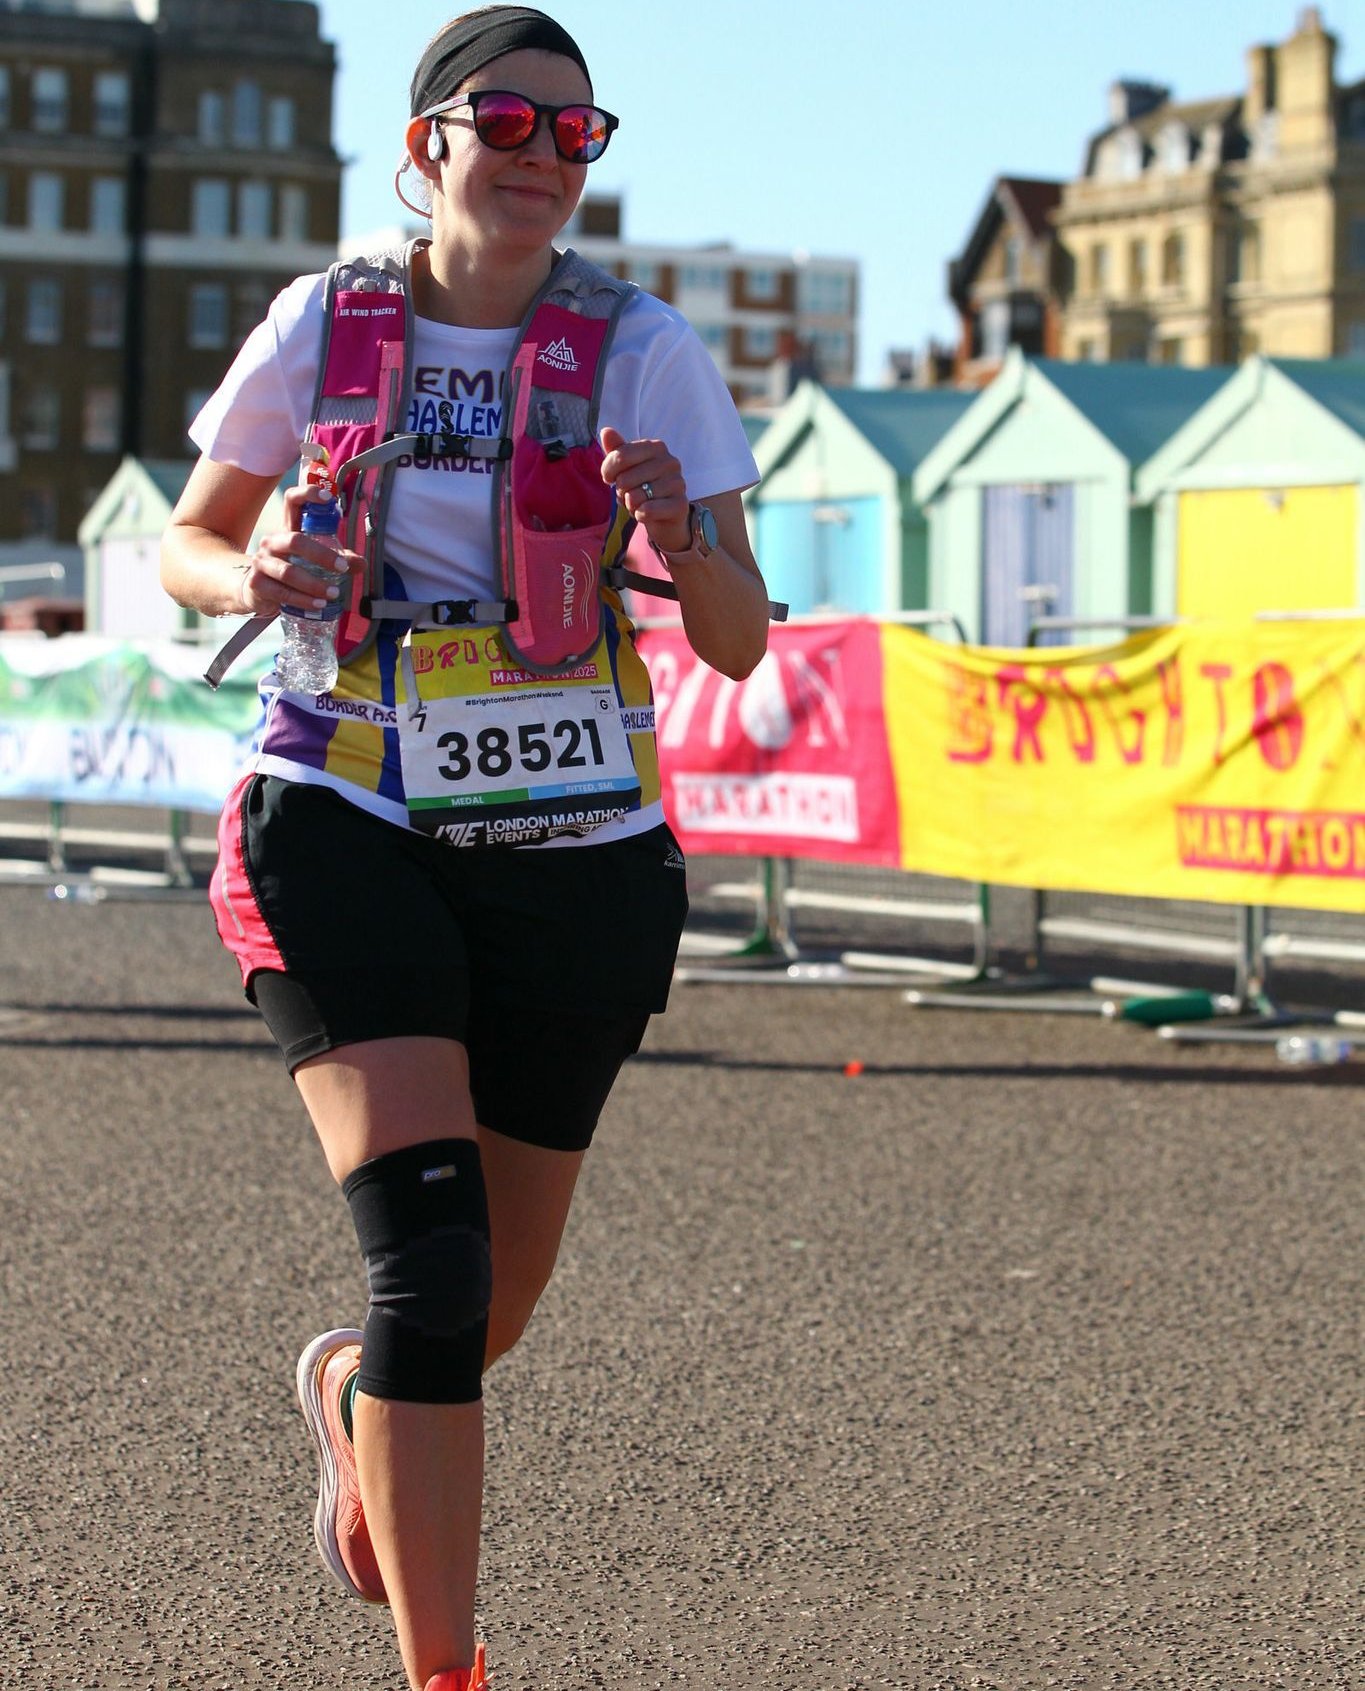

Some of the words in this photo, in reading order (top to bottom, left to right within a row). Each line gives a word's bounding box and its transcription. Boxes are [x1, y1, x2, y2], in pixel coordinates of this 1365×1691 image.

[351, 308, 369, 317] WIND
[371, 307, 397, 316] TRACKER
[537, 354, 578, 372] AONIJIE
[562, 563, 575, 630] AONIJIE
[573, 664, 597, 679] 2025
[599, 699, 609, 710] G
[436, 718, 605, 781] 38521
[451, 796, 485, 806] MEDAL
[486, 813, 549, 834] LONDON
[486, 829, 541, 845] EVENTS
